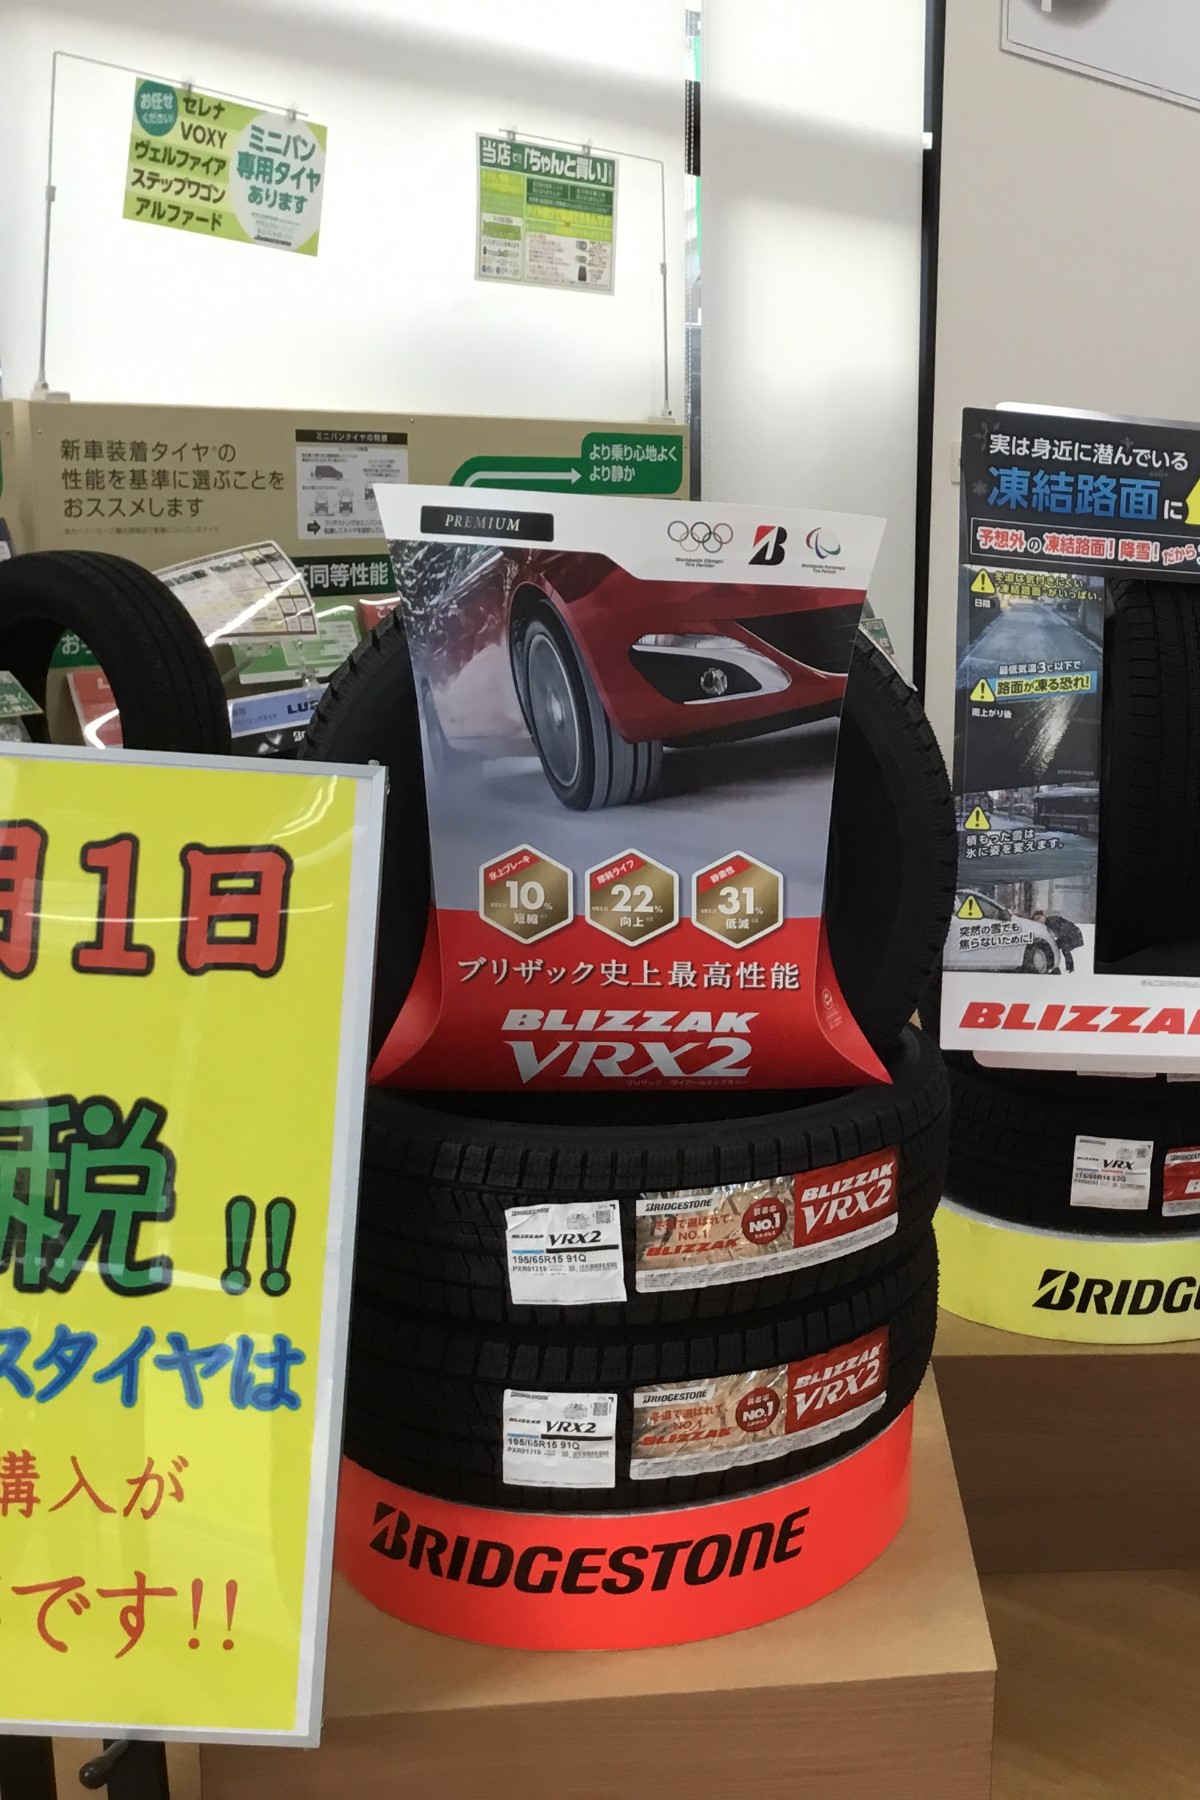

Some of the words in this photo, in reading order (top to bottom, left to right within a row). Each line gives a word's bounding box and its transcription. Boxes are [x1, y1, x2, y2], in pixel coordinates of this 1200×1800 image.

[140, 92, 173, 110] お任せ
[183, 97, 225, 120] セレナ
[181, 121, 227, 149] VOXY
[249, 125, 315, 161] ミニバン
[135, 140, 227, 176] ヴェルファイア
[237, 151, 321, 193] 専用タイヤ
[132, 168, 225, 204] ステップワゴン
[248, 185, 308, 214] あります
[135, 196, 223, 232] アルファード
[589, 444, 677, 462] より乗り心地よく
[989, 433, 1189, 471] 実は身近に潜んでいる
[61, 468, 285, 492] 性能を基準に選ぶことを
[589, 465, 635, 482] より静か
[988, 466, 1183, 521] 凍結路面に
[64, 498, 204, 518] おススメします
[444, 514, 521, 531] PREMIUM
[997, 676, 1090, 695] 路面が凍る恐れ!
[972, 708, 1012, 719] 雨上がり後
[966, 829, 1034, 846] 積もった雪は
[489, 855, 530, 881] 氷上ブレーキ
[513, 912, 538, 925] 短縮
[620, 916, 644, 928] 向上
[725, 918, 750, 930] 低減
[959, 923, 1020, 937] 突然の雪でも
[959, 932, 1033, 950] 焦らないために!
[458, 958, 801, 990] ブリザック史上最高性能
[500, 1009, 760, 1033] BLIZZAK
[502, 1038, 752, 1084] VRX2
[1103, 1159, 1135, 1170] VRX
[800, 1161, 894, 1202] BLIZZAK
[646, 1199, 713, 1211] BRIDGESTONE
[800, 1179, 892, 1235] VRX2
[749, 1213, 780, 1233] NO.1
[549, 1230, 601, 1246] VRX2
[678, 1230, 708, 1241] NO.1
[646, 1238, 740, 1256] BLIZZAK
[512, 1255, 563, 1263] 195/65R15
[567, 1254, 587, 1262] 91Q
[794, 1342, 882, 1389] BLIZZAK
[643, 1390, 708, 1403] BRIDGESTONE
[794, 1359, 881, 1420] VRX2
[743, 1401, 773, 1422] NO.1
[546, 1421, 596, 1433] VRX2
[640, 1427, 734, 1446] BLIZZAK
[560, 1441, 579, 1450] 91Q
[369, 1502, 810, 1596] BRIDGESTONE
